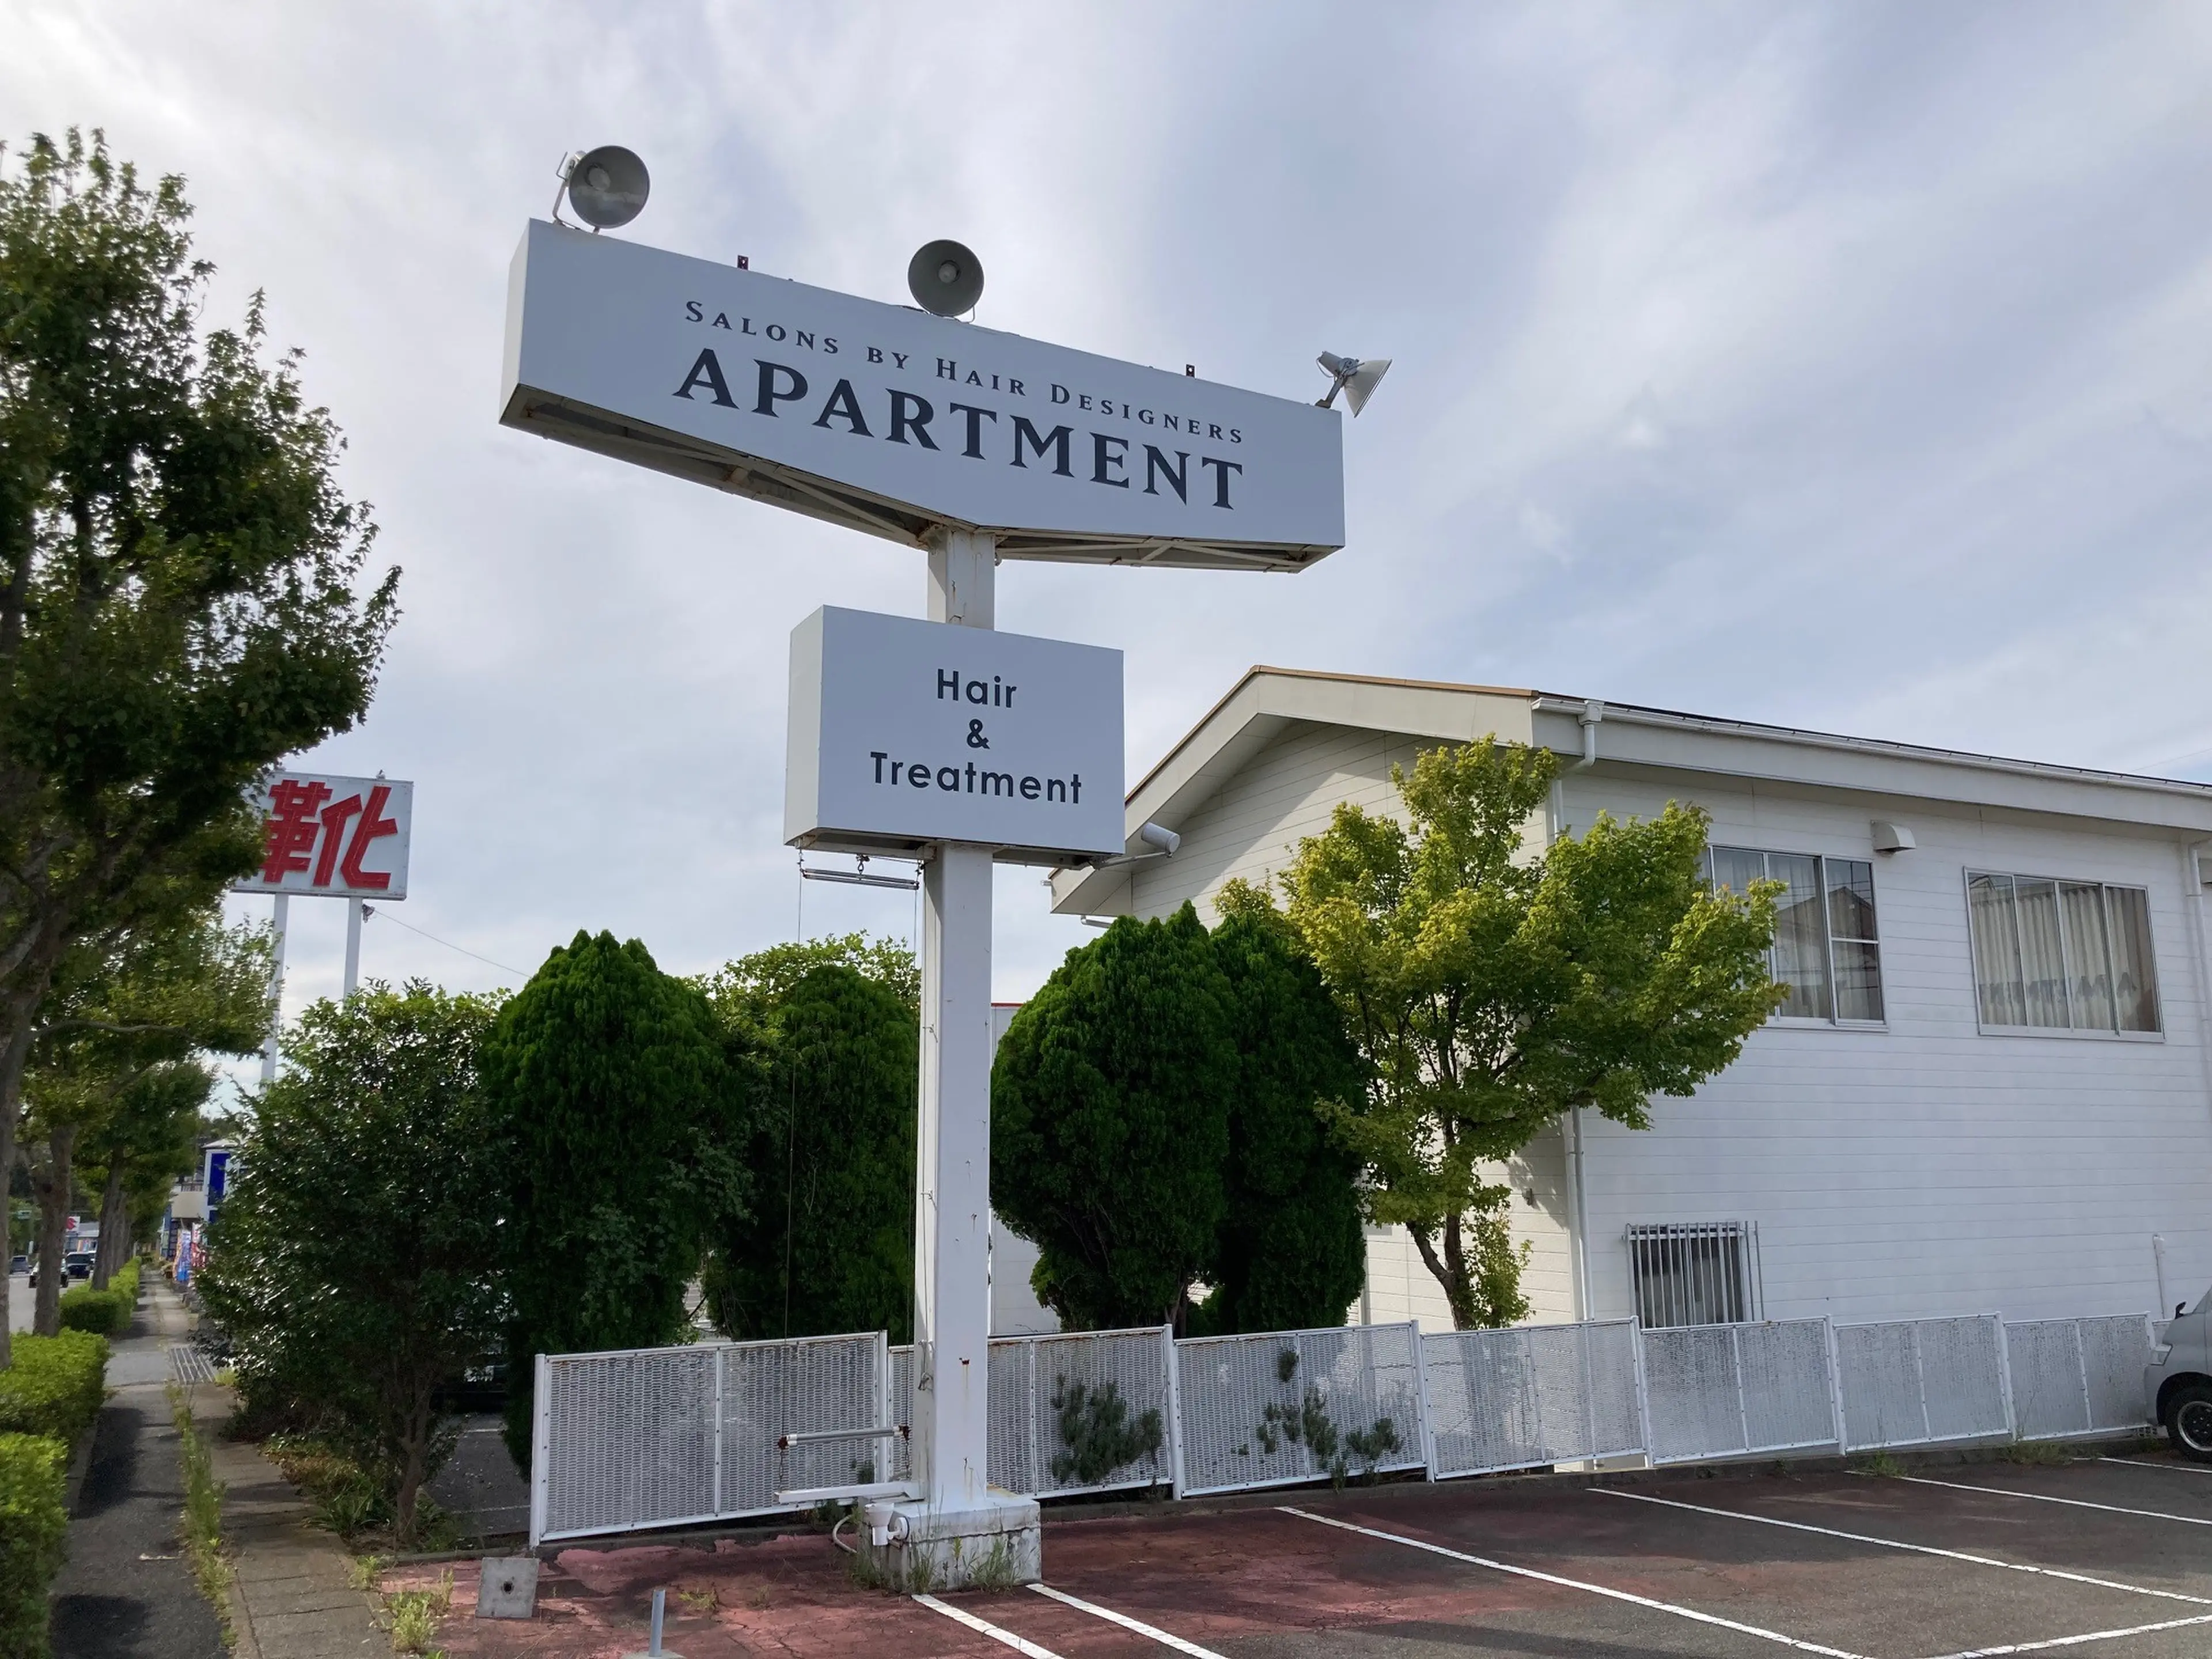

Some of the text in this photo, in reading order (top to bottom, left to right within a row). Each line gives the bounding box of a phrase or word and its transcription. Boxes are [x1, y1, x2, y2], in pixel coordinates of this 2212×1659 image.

[684, 300, 1243, 445] SALONS BY HAIR DESIGNERS
[671, 347, 1243, 510] APARTMENT
[937, 668, 1018, 709] Hair
[966, 718, 991, 749] &
[870, 751, 1082, 805] Treatment
[259, 779, 399, 890] 靴
